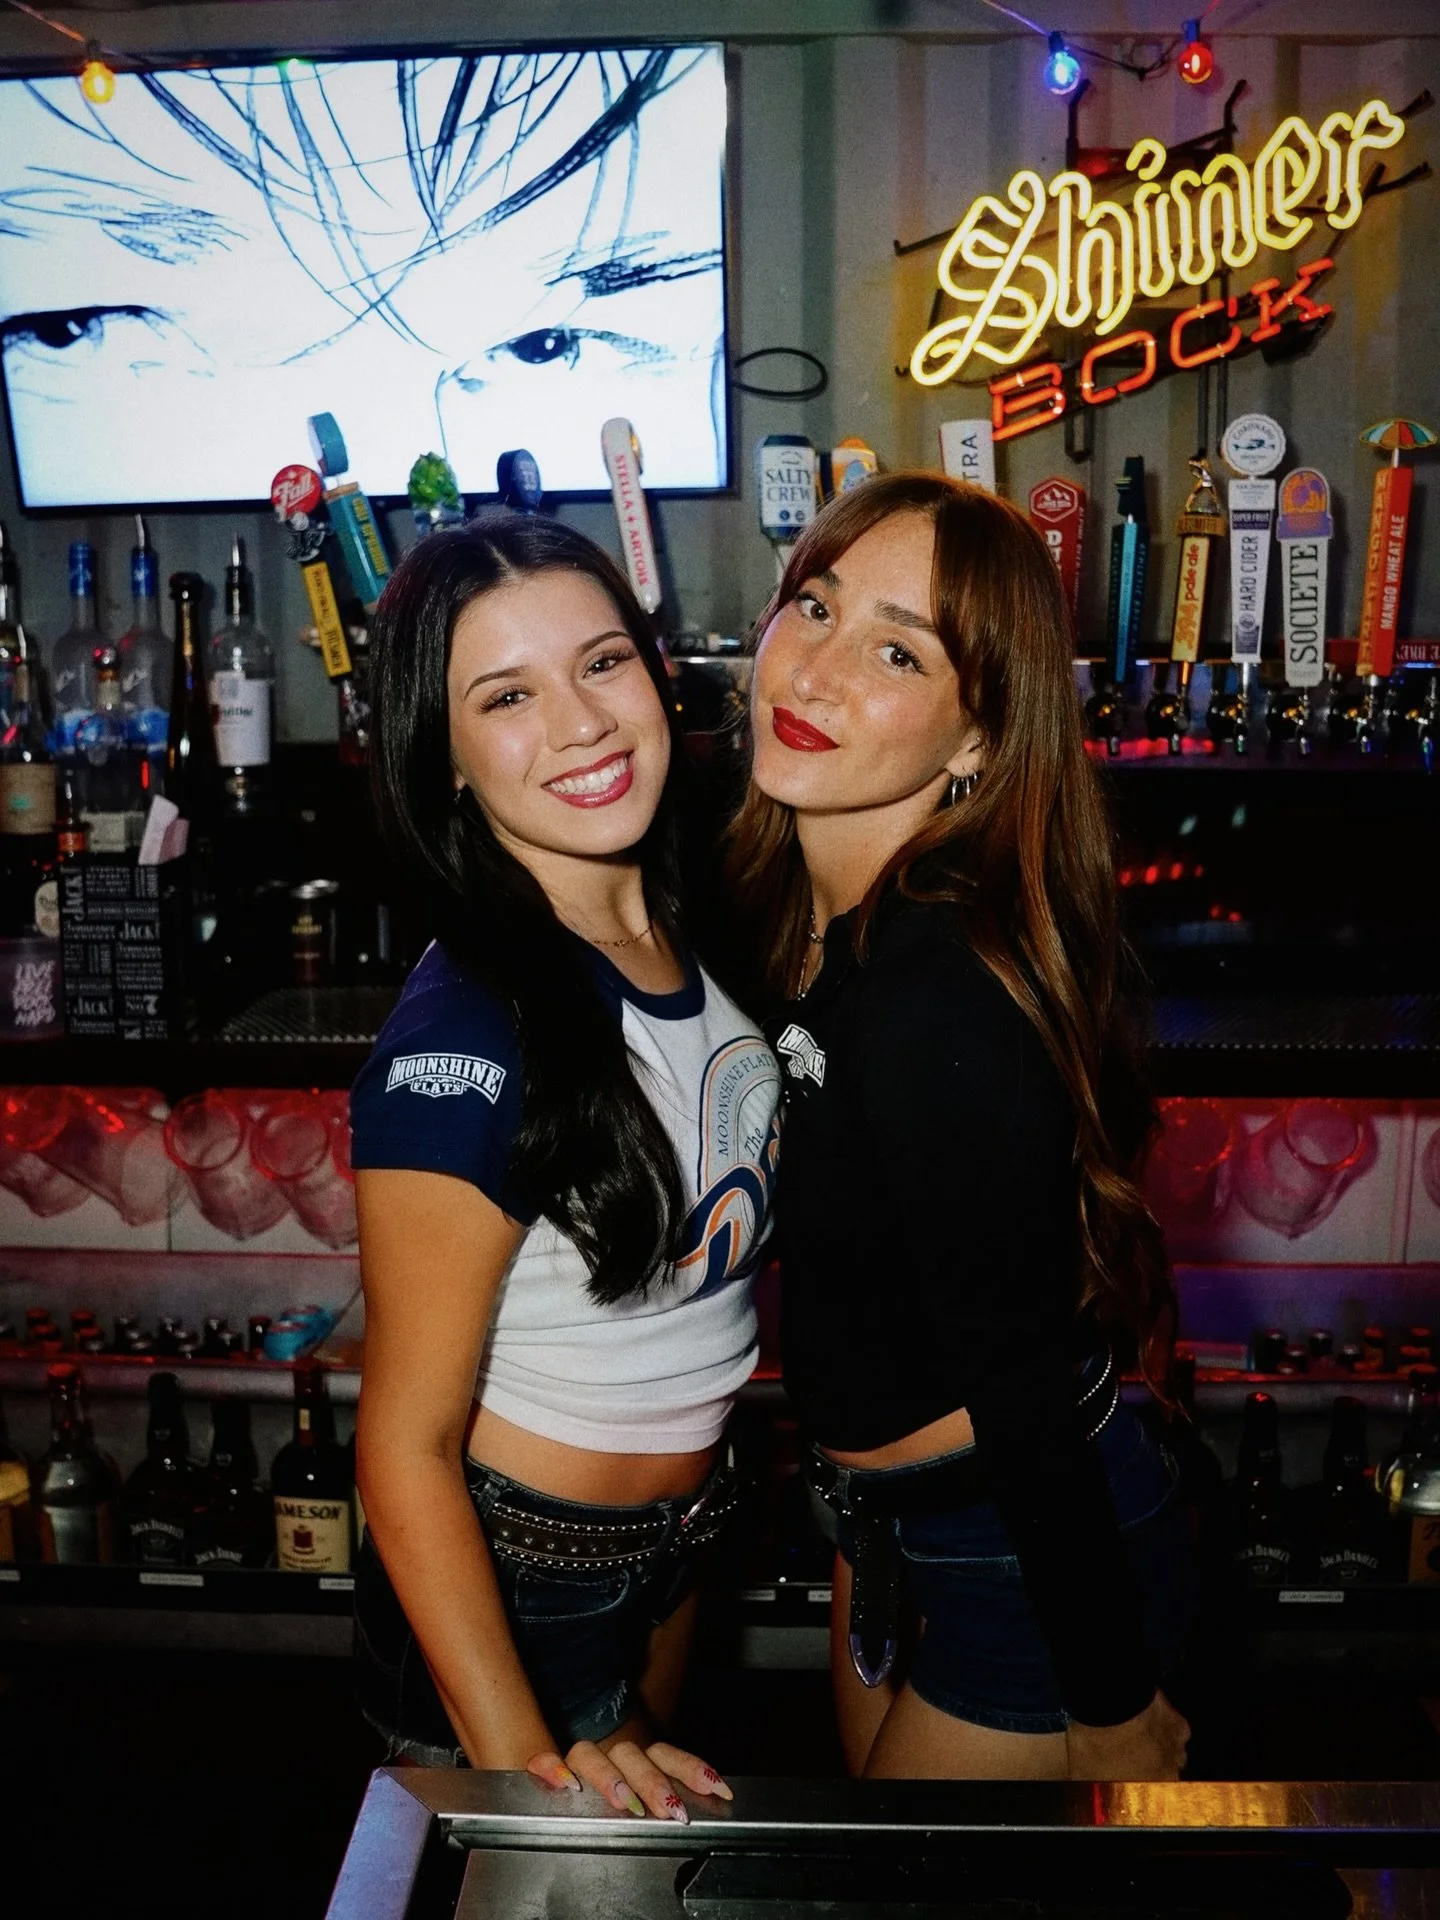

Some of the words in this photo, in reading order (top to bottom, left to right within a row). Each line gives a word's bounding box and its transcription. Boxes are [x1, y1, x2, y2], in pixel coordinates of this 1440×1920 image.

[909, 98, 1406, 387] Shiner
[988, 257, 1336, 442] BOCK
[275, 476, 317, 516] Fall
[766, 468, 812, 486] SALTY
[767, 487, 811, 502] CREW
[614, 453, 637, 510] STELLA
[628, 525, 649, 589] ARTOIS
[1391, 514, 1406, 539] ALE
[1188, 543, 1200, 562] ale
[1241, 535, 1258, 573] CIDER
[1385, 540, 1402, 584] WHEAT
[1184, 569, 1198, 601] pale
[1240, 577, 1258, 612] HARD
[1290, 544, 1318, 664] SOCIETE
[1380, 588, 1397, 630] MANGO
[390, 1057, 502, 1095] MOONSHINE
[413, 1081, 461, 1093] FLATS
[718, 1065, 744, 1156] MOONSHINE
[744, 1127, 764, 1158] The
[275, 1500, 341, 1520] AMESON
